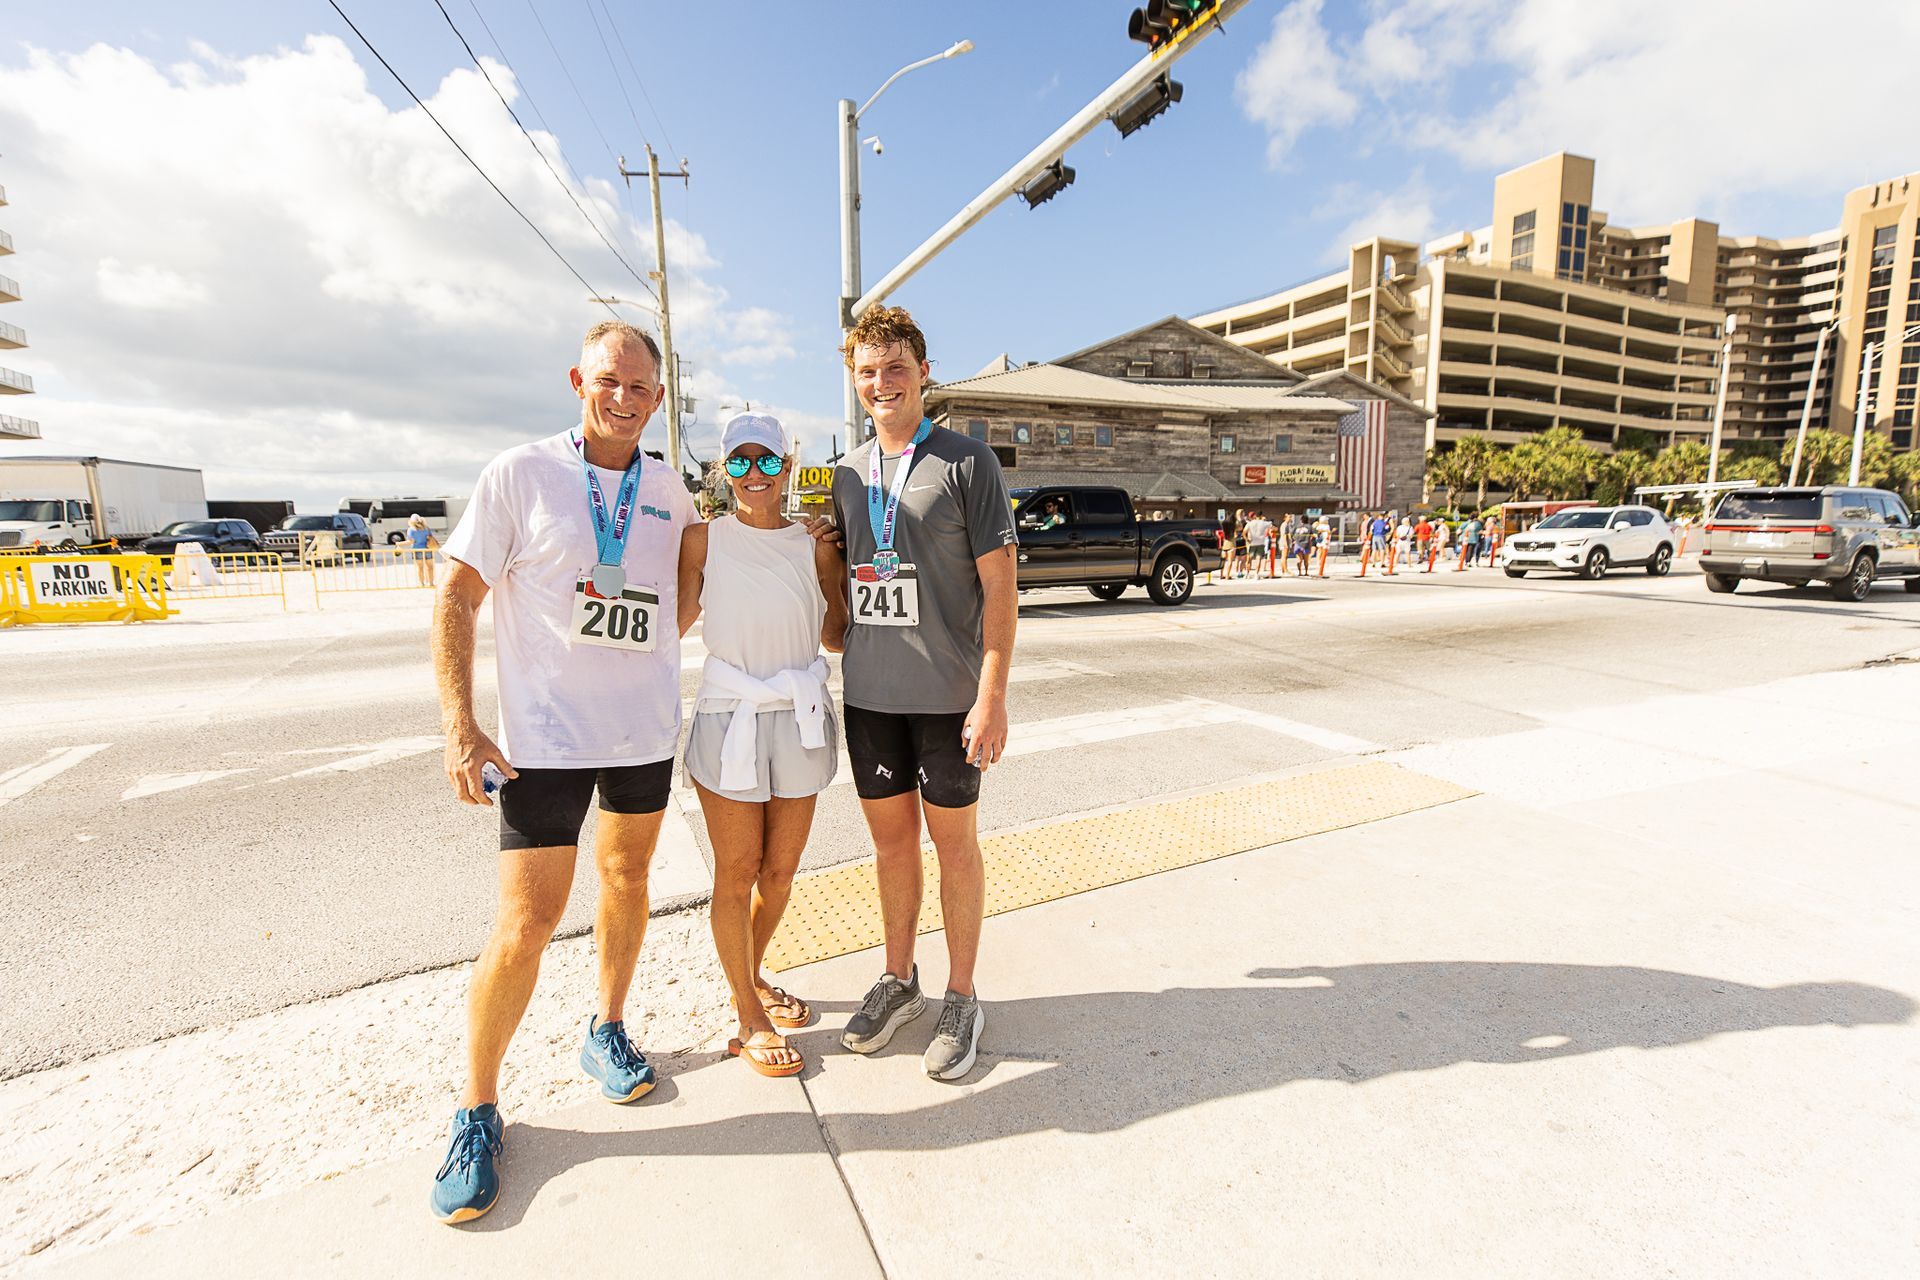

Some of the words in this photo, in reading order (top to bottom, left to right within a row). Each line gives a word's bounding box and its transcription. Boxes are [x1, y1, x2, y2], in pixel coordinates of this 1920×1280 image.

[799, 467, 834, 489] LOR
[53, 564, 90, 580] NO
[41, 580, 108, 597] PARKING
[857, 585, 908, 617] 241
[580, 600, 649, 643] 208
